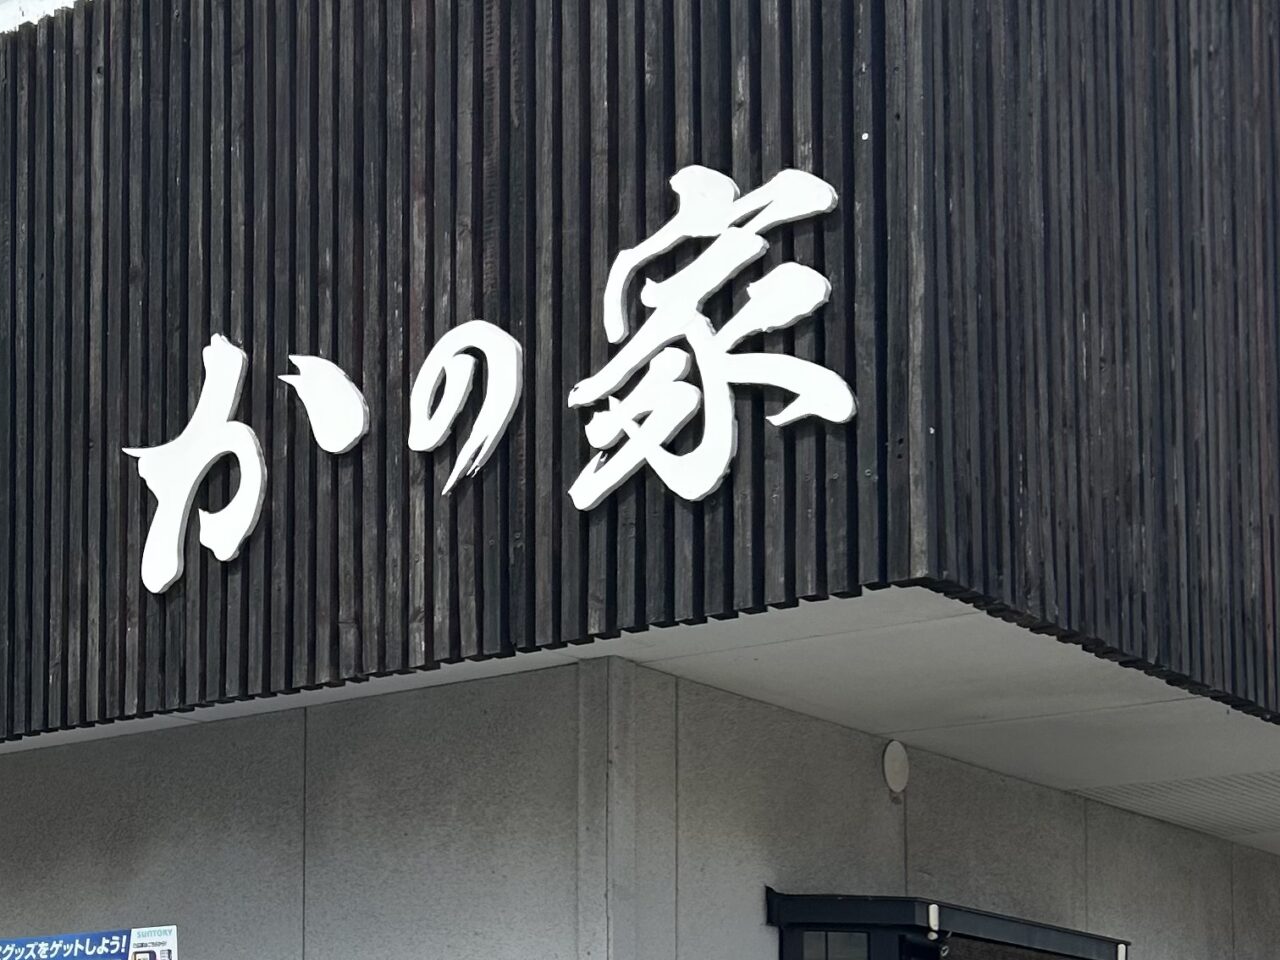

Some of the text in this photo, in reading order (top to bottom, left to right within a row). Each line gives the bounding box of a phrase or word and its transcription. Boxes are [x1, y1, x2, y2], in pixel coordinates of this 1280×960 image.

[123, 164, 858, 595] かの家
[137, 929, 173, 938] SUNTORY
